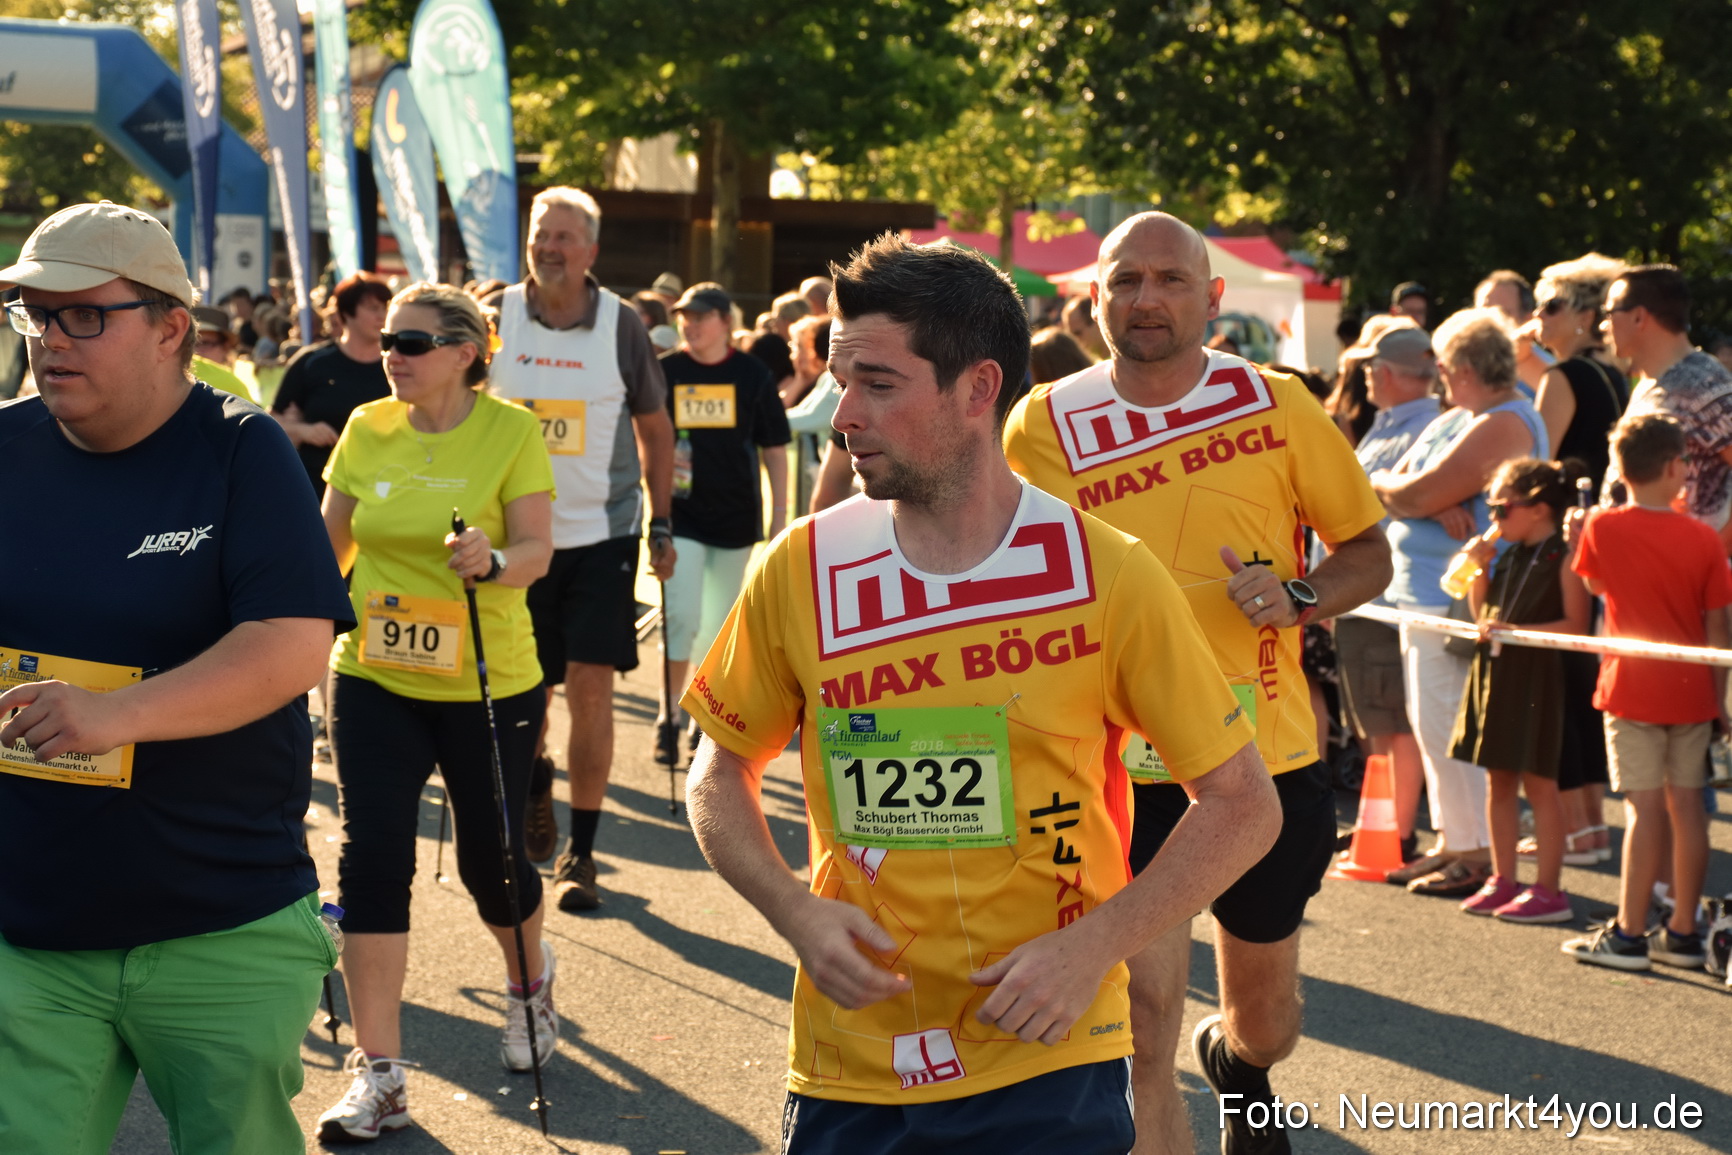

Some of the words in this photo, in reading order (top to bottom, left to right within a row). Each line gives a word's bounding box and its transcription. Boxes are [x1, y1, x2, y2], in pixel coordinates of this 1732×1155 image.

[684, 401, 725, 415] 1701
[1077, 461, 1170, 511] MAX
[1180, 424, 1286, 475] BÖGL
[127, 531, 191, 559] JURA
[383, 620, 440, 653] 910
[821, 652, 946, 709] MAX
[961, 623, 1102, 682] BÖGL
[840, 730, 901, 742] firmenlauf
[11, 742, 36, 756] Walte
[910, 740, 944, 751] 2018
[83, 765, 99, 773] e.V.
[844, 757, 985, 808] 1232
[855, 811, 916, 824] Schubert
[920, 811, 979, 823] Thomas
[854, 824, 871, 834] Max
[873, 825, 893, 837] Bögl
[896, 826, 950, 836] Bauservice
[952, 825, 983, 834] GmbH
